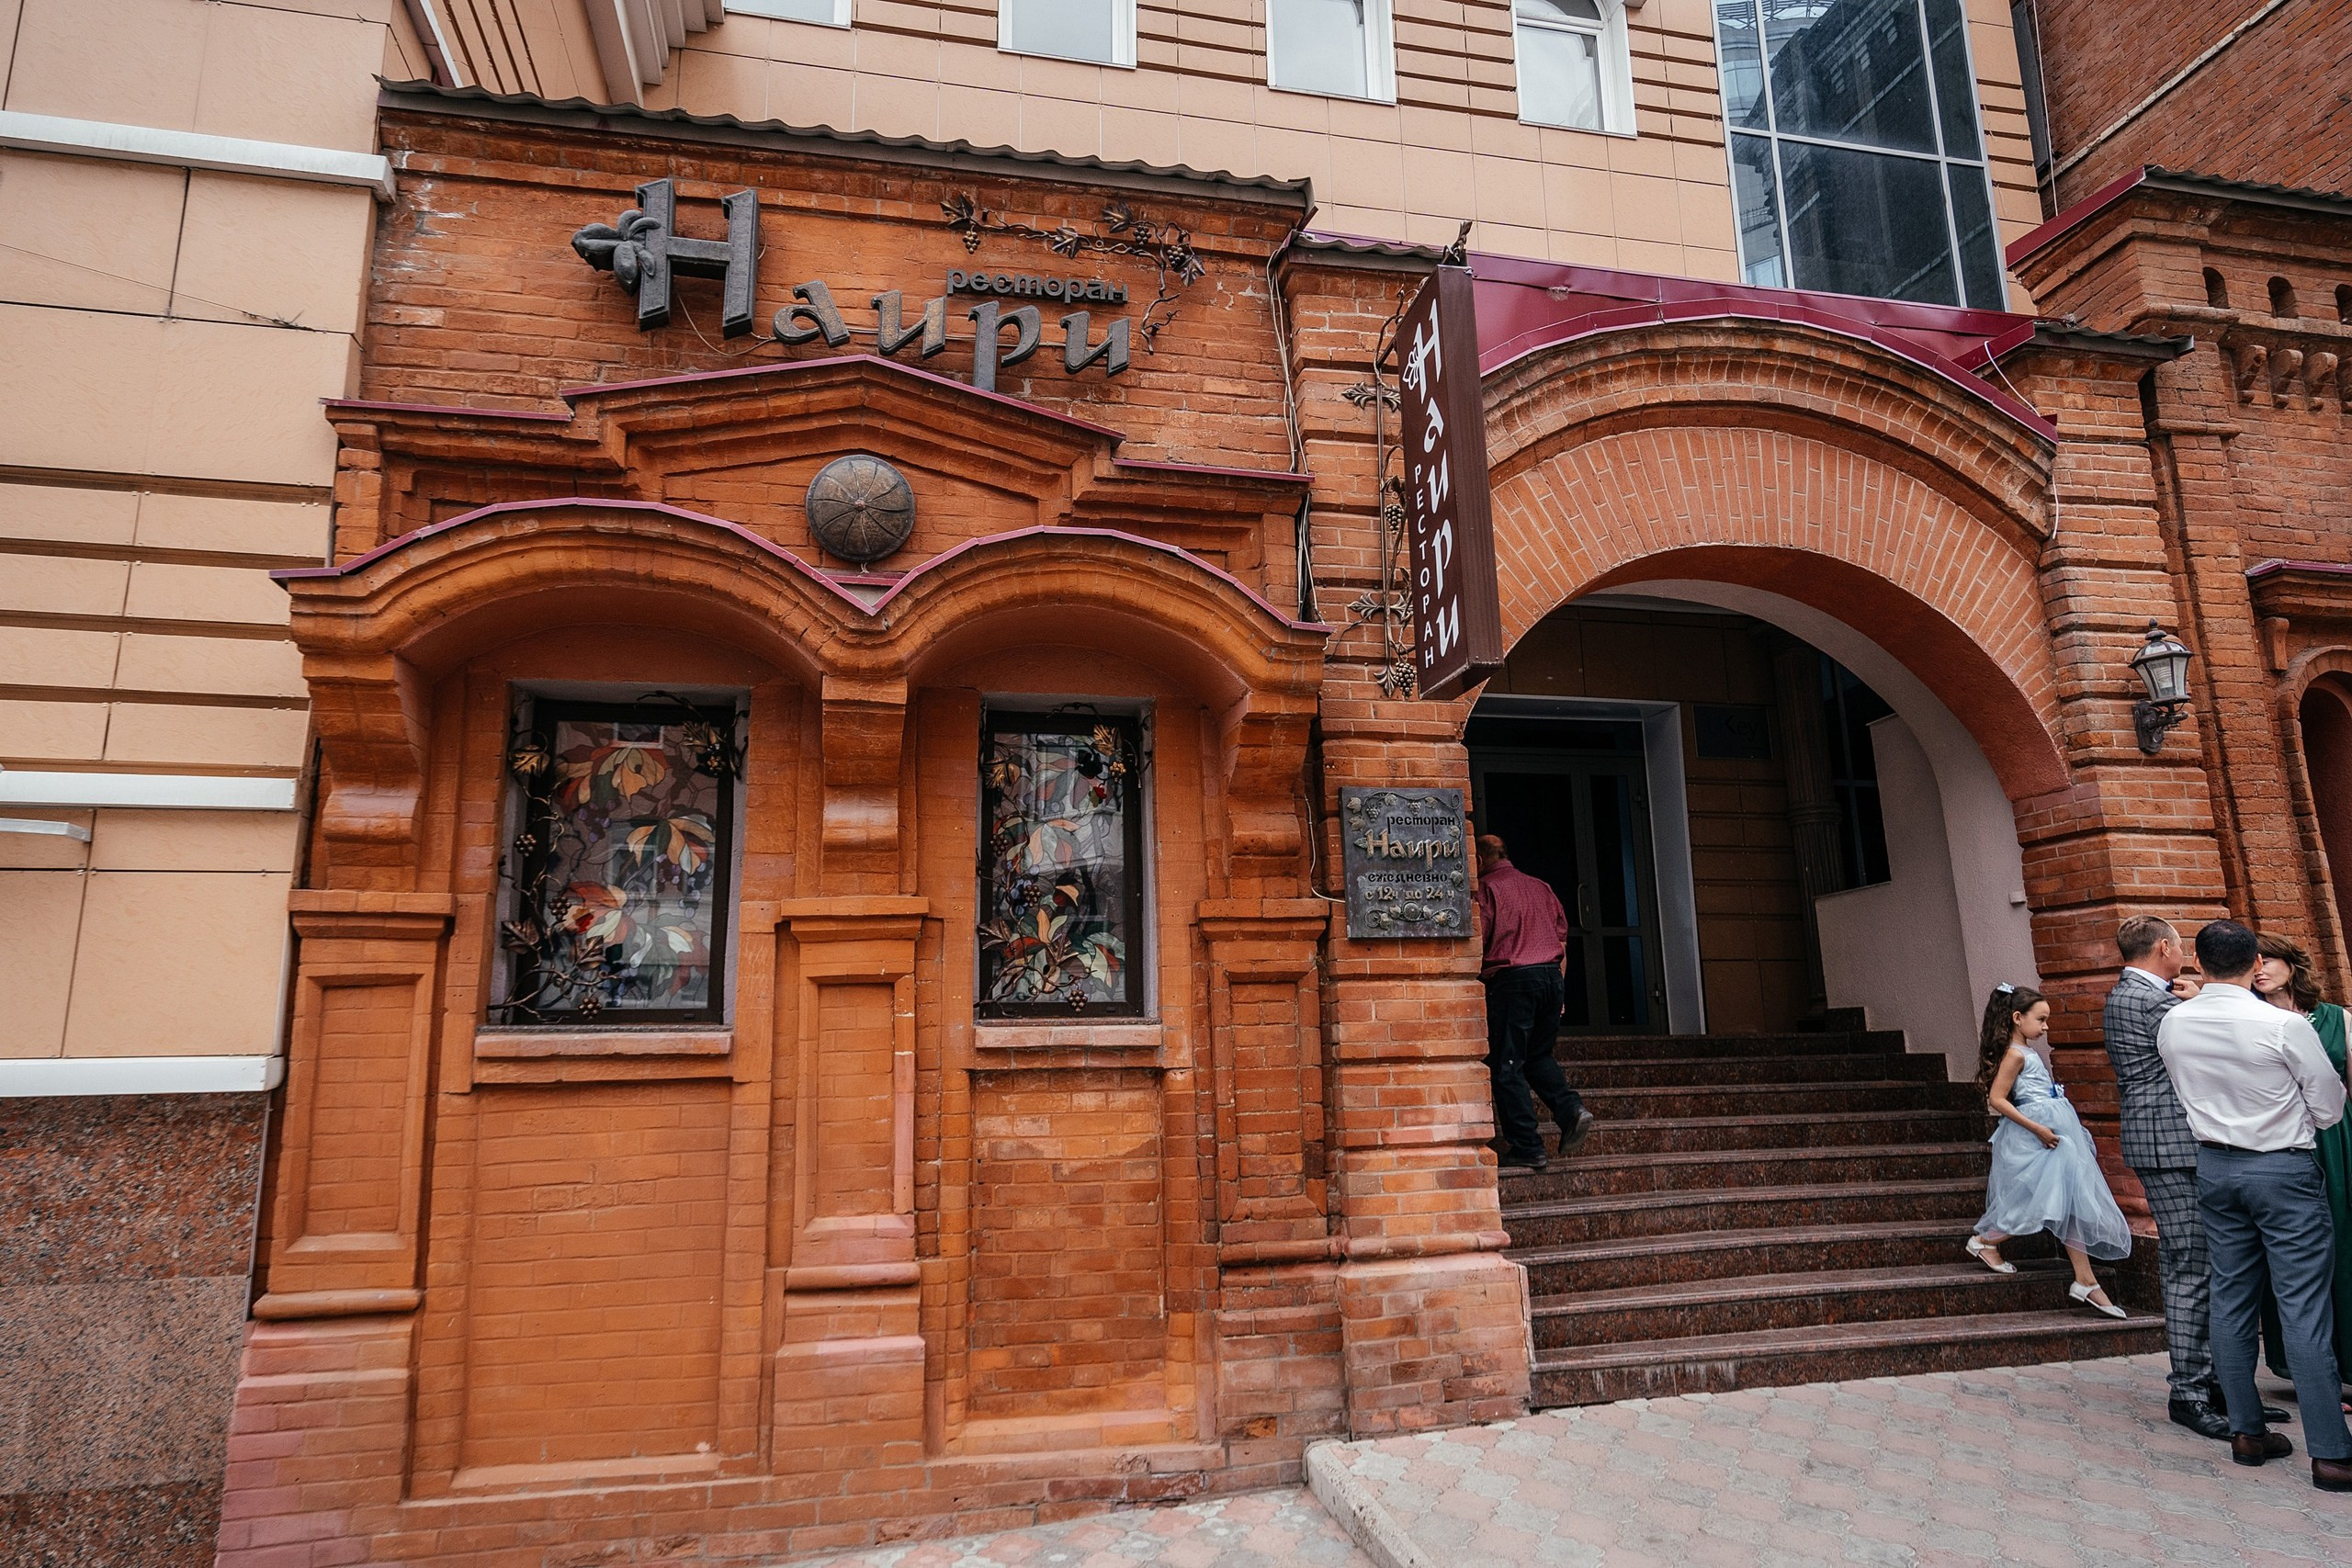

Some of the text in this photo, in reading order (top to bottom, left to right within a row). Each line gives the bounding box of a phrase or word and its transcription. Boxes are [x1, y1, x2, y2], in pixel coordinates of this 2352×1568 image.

[634, 177, 1130, 393] Наири
[945, 267, 1129, 305] ресторан
[1412, 298, 1461, 658] Наири
[1414, 463, 1435, 670] РЕСТОРАН
[1387, 815, 1455, 834] ресторан
[1364, 829, 1460, 869] Наири
[1367, 874, 1448, 883] ежедневно
[1404, 889, 1423, 900] до
